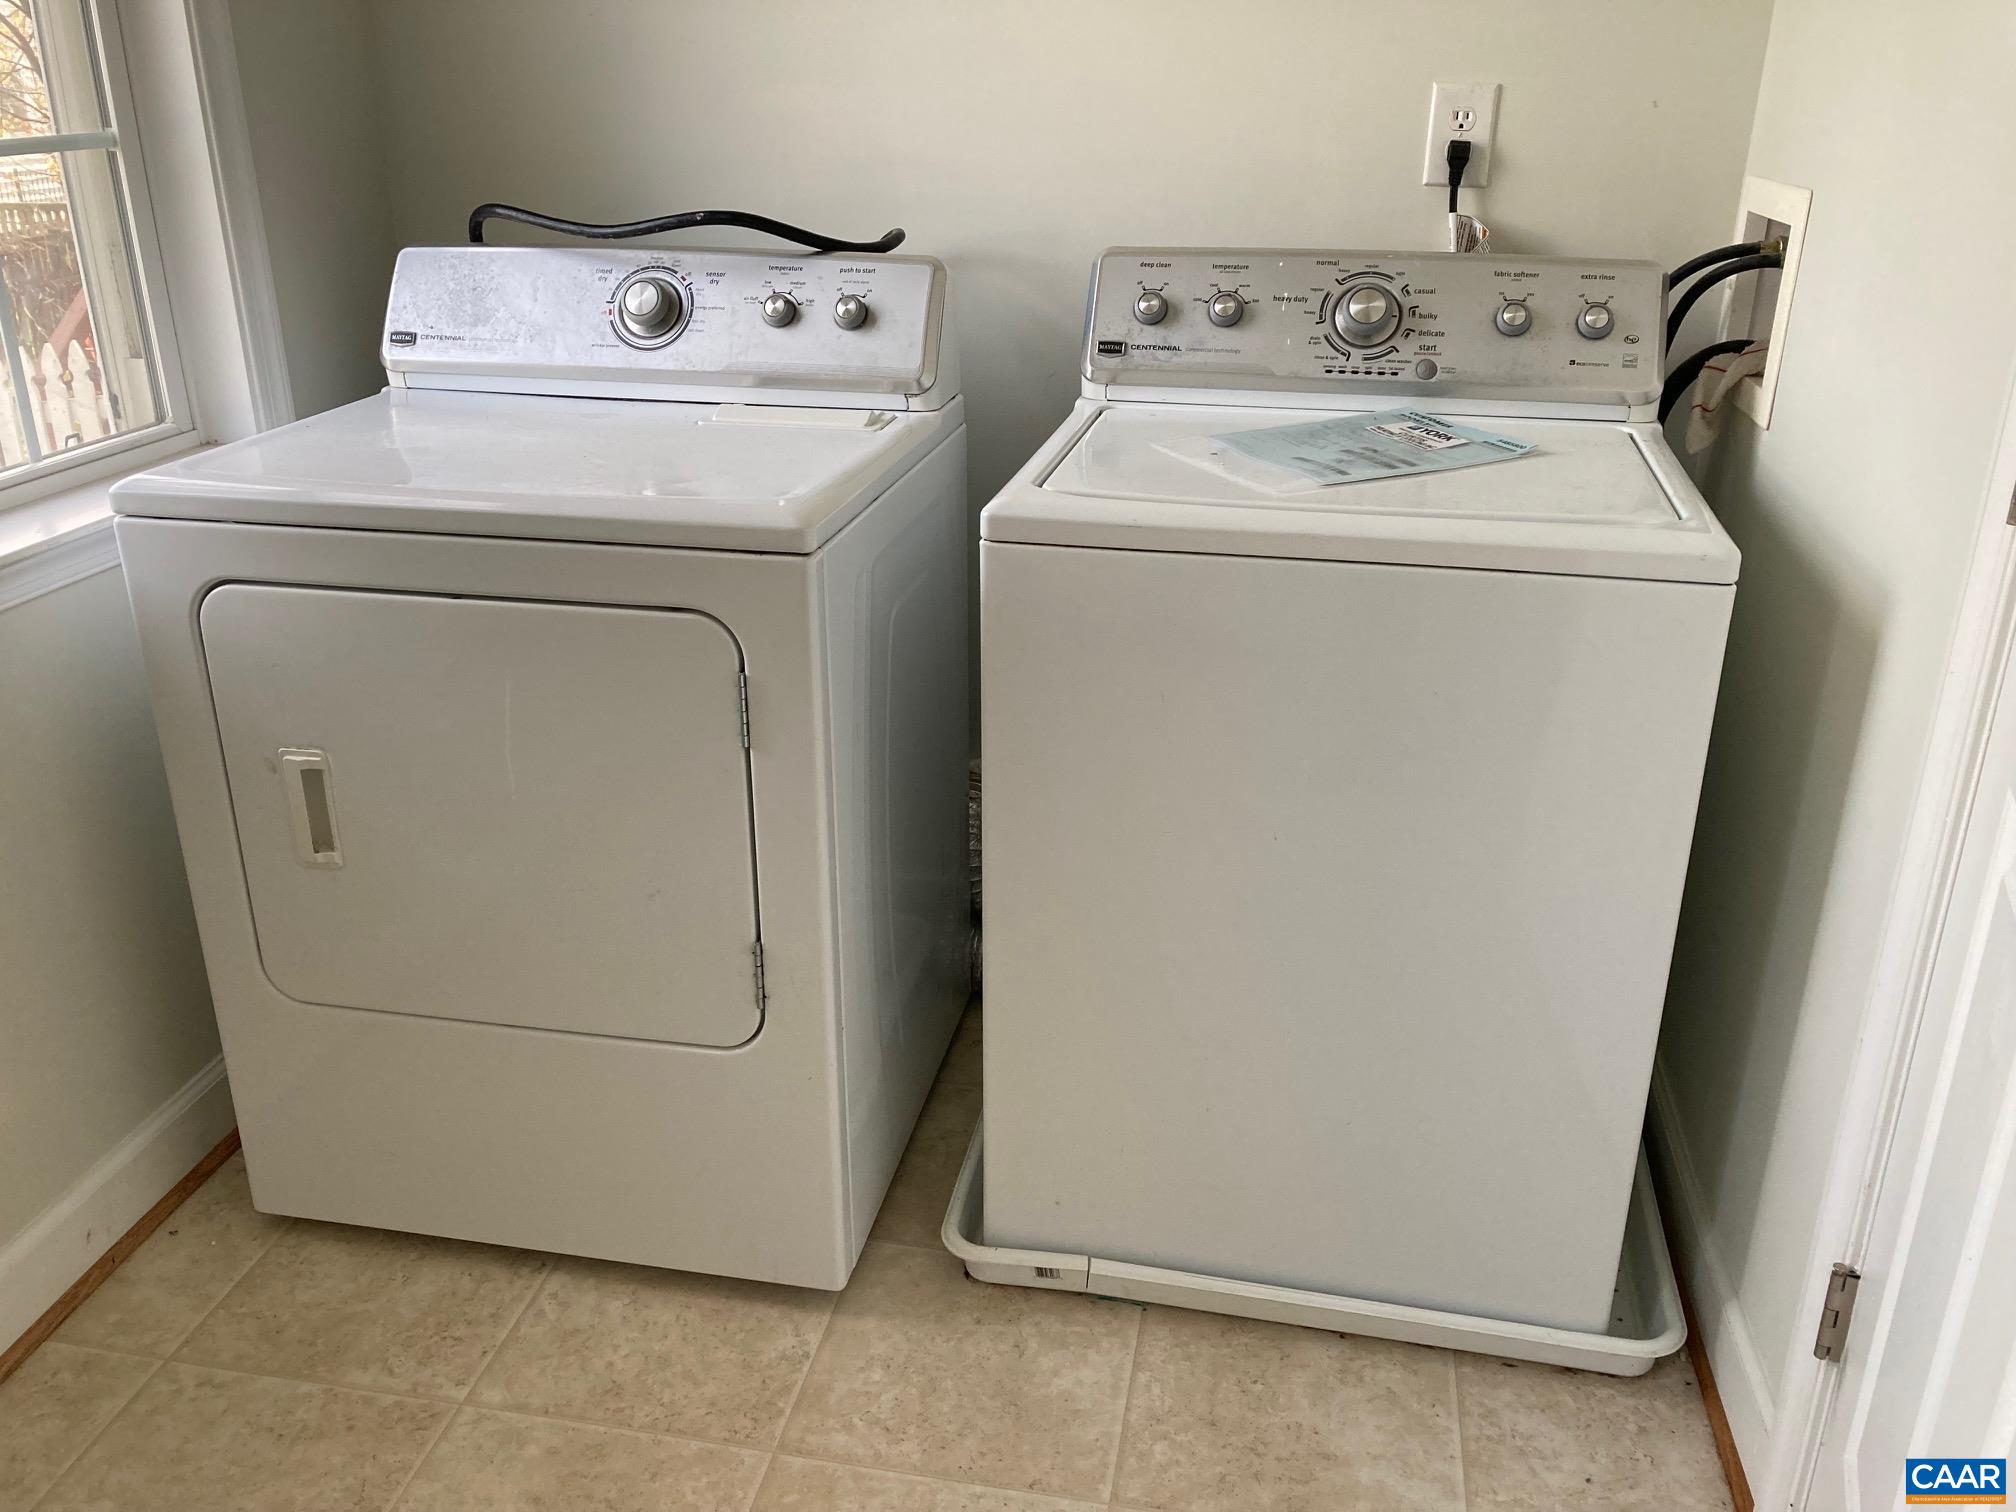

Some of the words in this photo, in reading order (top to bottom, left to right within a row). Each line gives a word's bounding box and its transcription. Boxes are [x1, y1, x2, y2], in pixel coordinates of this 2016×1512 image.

[768, 264, 804, 272] temperature
[1140, 261, 1155, 269] deep
[1212, 263, 1250, 271] temperature
[595, 267, 613, 275] timed
[839, 266, 854, 274] push
[1494, 270, 1512, 278] fabric
[1513, 271, 1540, 279] softener
[597, 275, 608, 283] dry
[709, 278, 720, 286] dry
[1413, 287, 1436, 295] casual
[1272, 294, 1293, 303] heavy
[1293, 295, 1309, 303] duty
[1418, 312, 1438, 320] bulky
[1098, 343, 1122, 351] MAYTAG
[1130, 344, 1183, 352] CENTENNIAL
[1420, 427, 1457, 442] YORK
